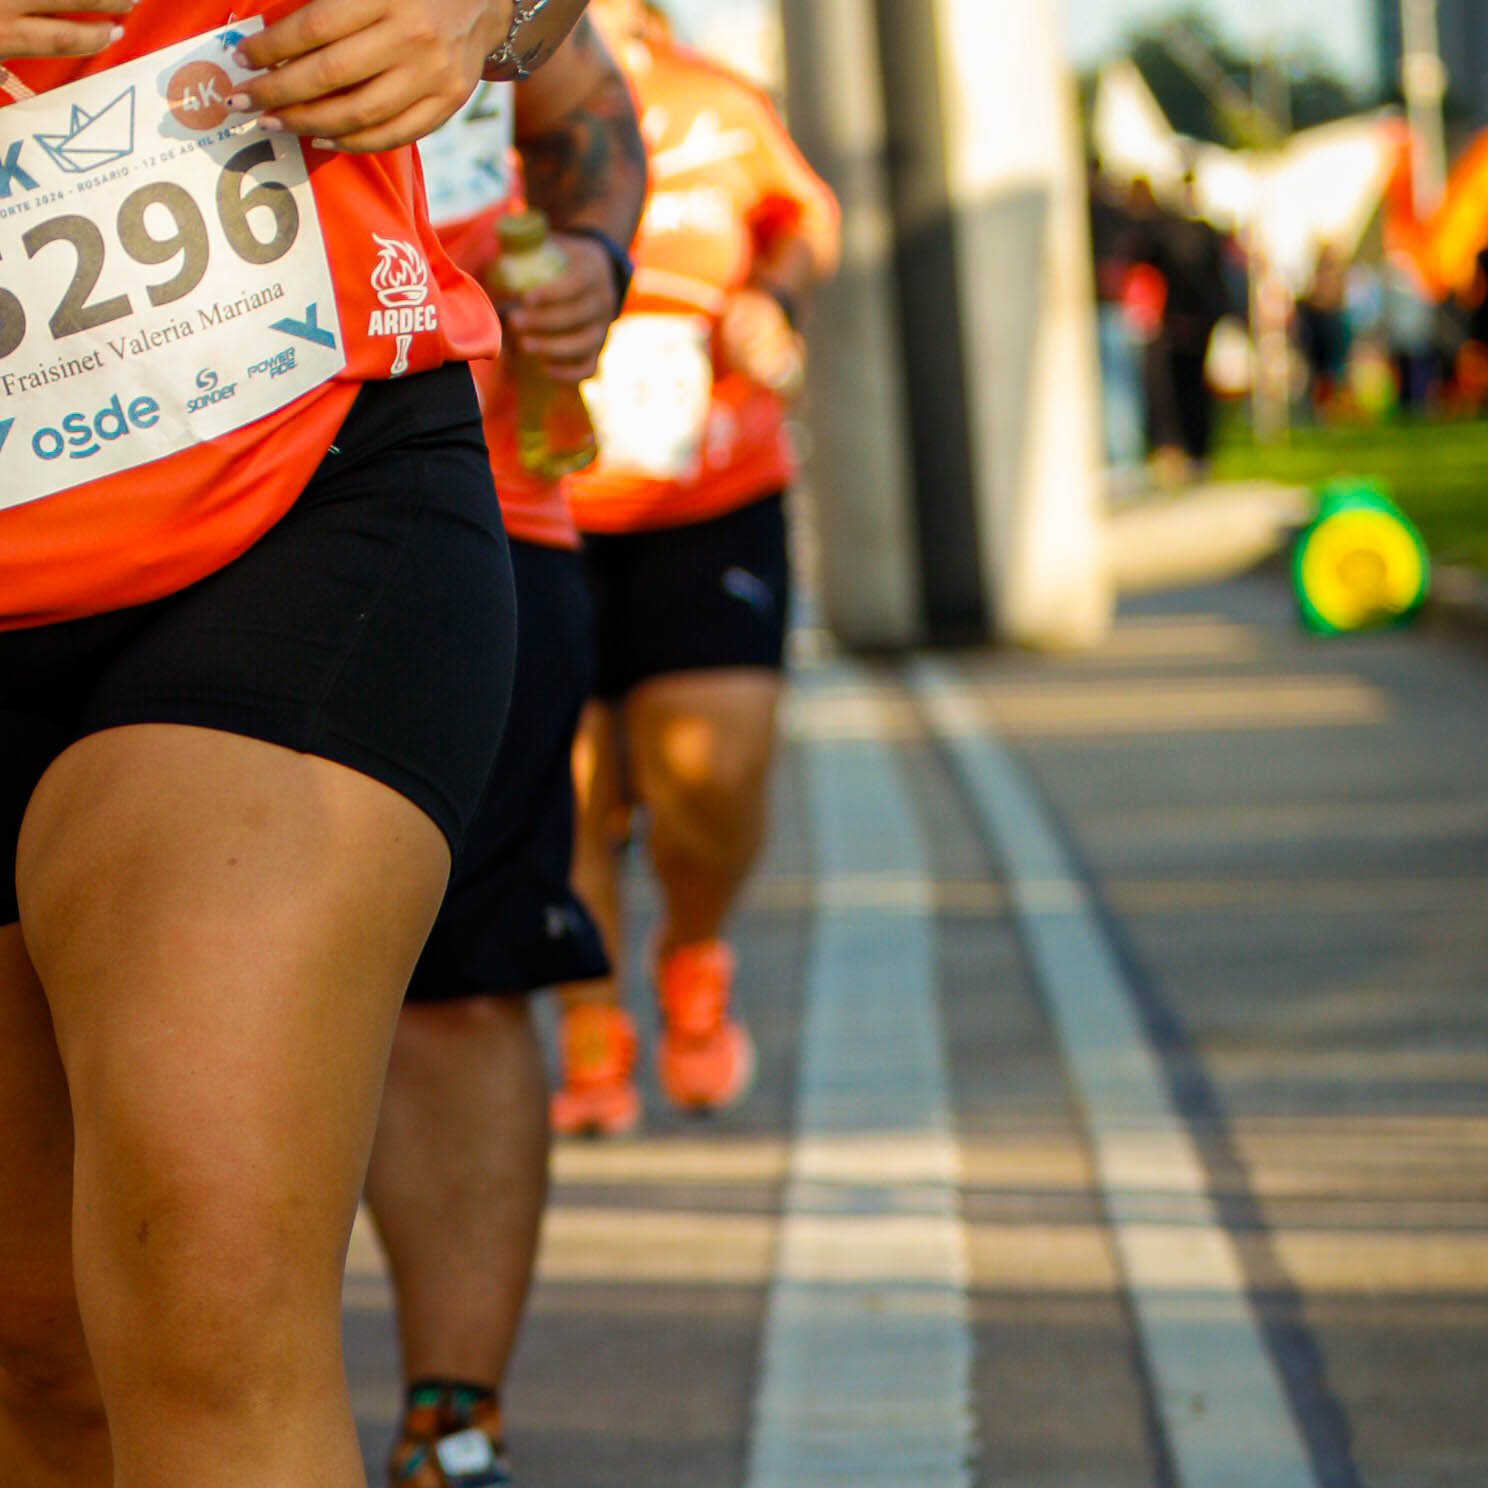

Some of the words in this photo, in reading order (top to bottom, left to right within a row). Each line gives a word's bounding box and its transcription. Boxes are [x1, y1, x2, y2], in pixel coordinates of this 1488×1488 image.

[76, 167, 130, 192] ROSARIO
[160, 148, 177, 163] DE
[0, 348, 105, 397] Fraisinet
[107, 319, 194, 361] Valeria
[196, 282, 285, 331] Mariana
[367, 304, 438, 337] ARDEC
[247, 345, 296, 379] POWER
[31, 393, 161, 460] osde
